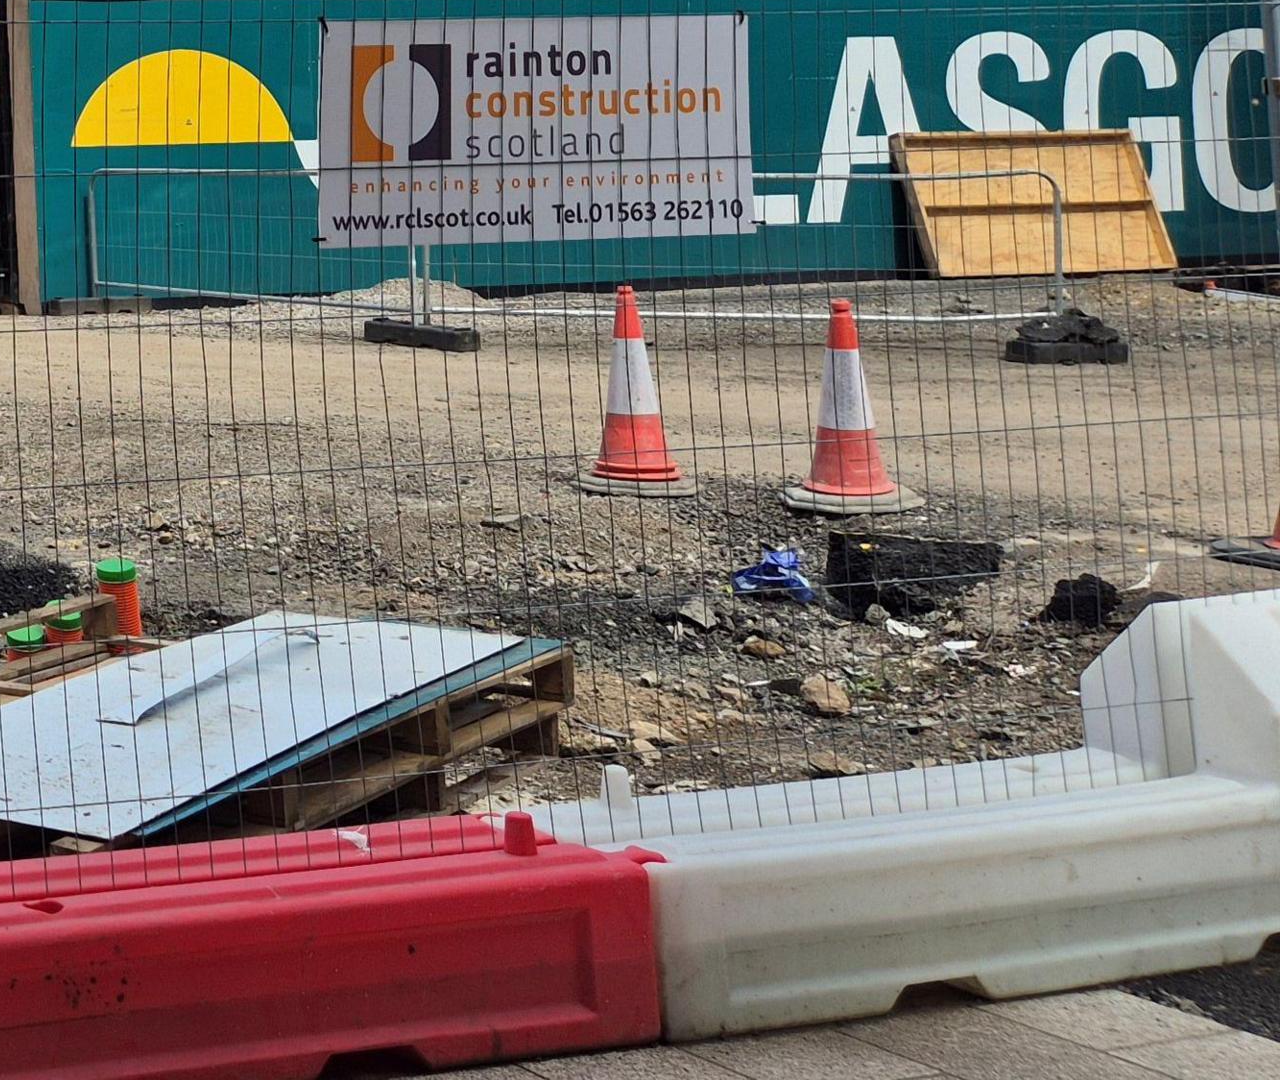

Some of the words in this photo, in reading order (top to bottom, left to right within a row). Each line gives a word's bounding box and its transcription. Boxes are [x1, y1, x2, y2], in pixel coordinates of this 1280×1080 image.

[466, 42, 612, 78] rainton
[464, 79, 722, 118] construction
[465, 122, 625, 159] scotland
[351, 176, 479, 195] enhancing
[495, 174, 550, 194] your
[565, 169, 724, 189] environment
[332, 203, 533, 232] www.rclscot.co.uk
[663, 198, 744, 221] 262110
